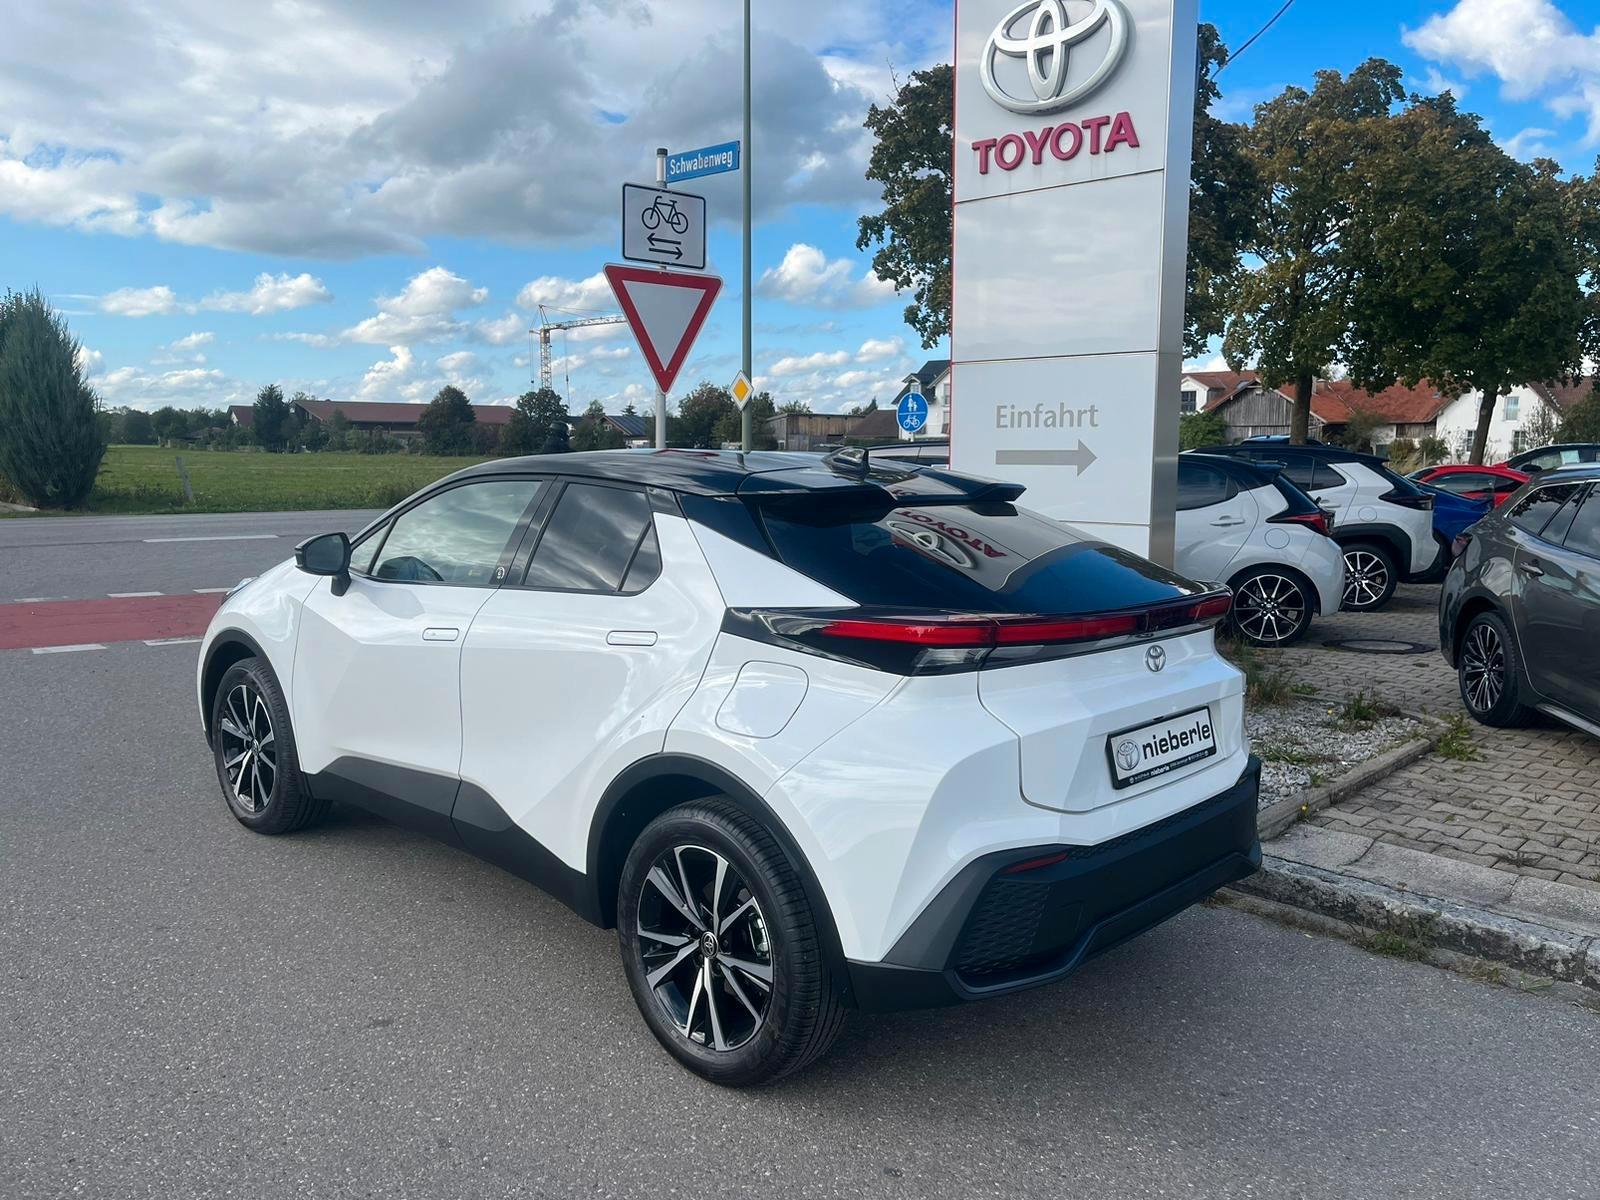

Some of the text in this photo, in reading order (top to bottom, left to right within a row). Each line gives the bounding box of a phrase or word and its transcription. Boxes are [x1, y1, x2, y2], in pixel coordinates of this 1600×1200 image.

[971, 111, 1140, 174] TOYOTA
[670, 150, 733, 175] Schwabenweg
[996, 402, 1099, 428] Einfahrt
[1142, 721, 1211, 760] nieberle
